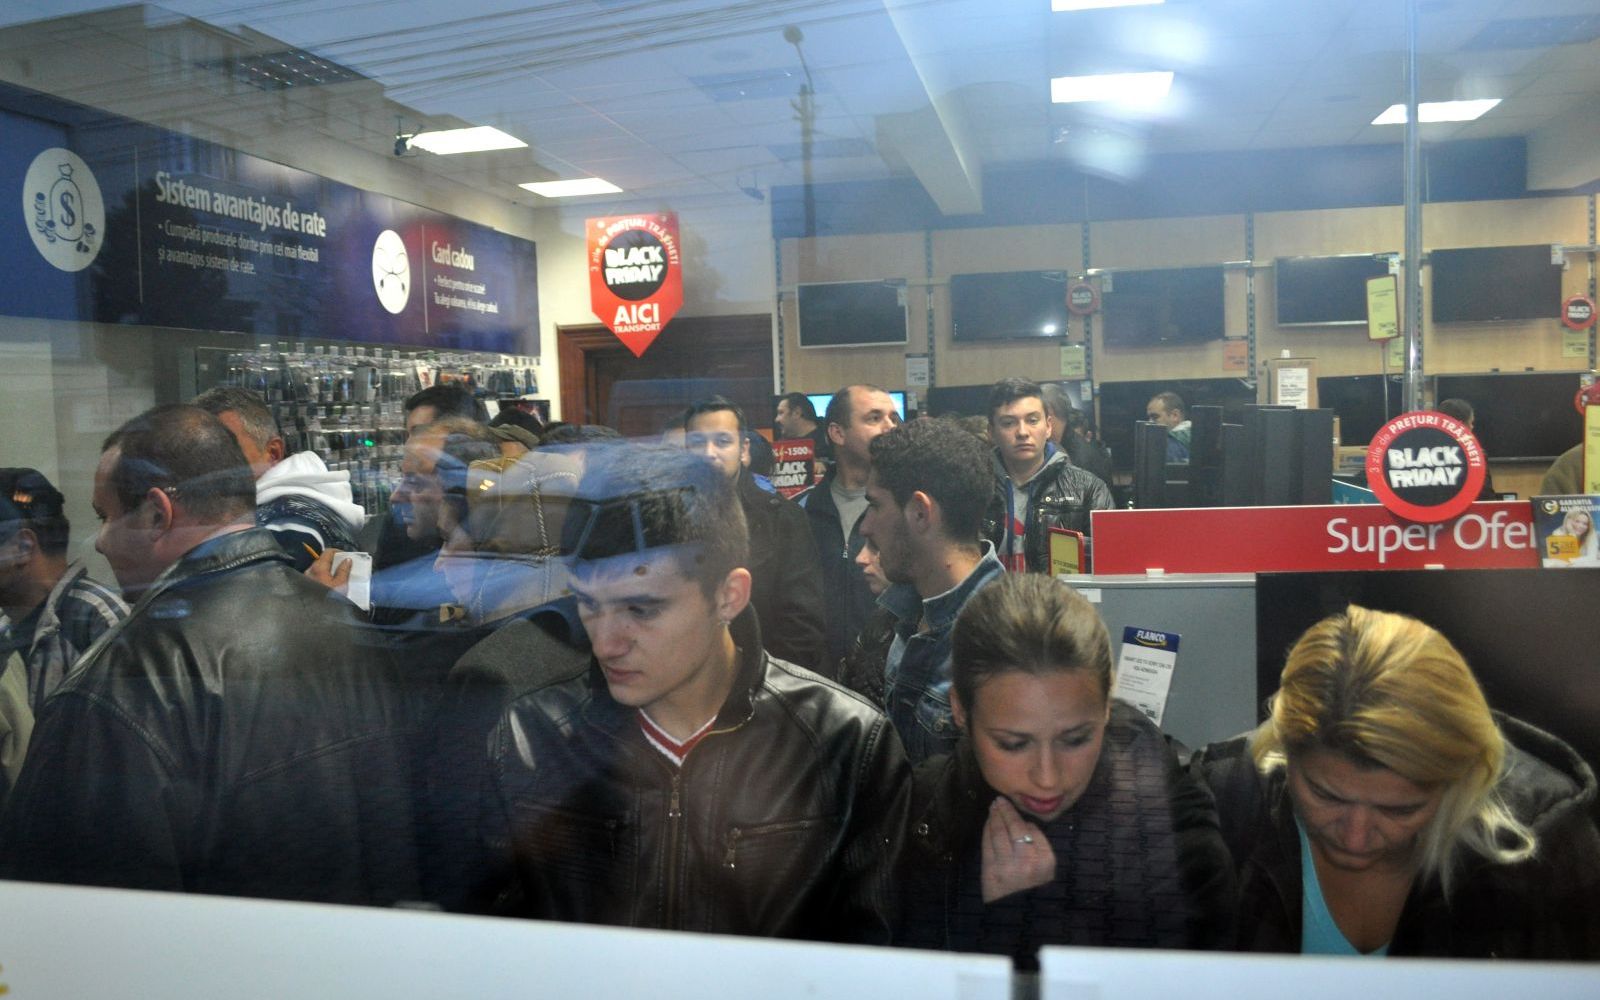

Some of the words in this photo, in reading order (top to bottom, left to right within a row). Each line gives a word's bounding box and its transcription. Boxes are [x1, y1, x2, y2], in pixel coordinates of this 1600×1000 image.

[155, 170, 211, 212] Sistem
[213, 191, 281, 232] avantajos
[282, 202, 300, 231] de
[301, 211, 327, 238] rate
[166, 249, 206, 270] avantajos
[205, 252, 230, 270] sistem
[230, 256, 240, 272] de
[432, 240, 451, 266] Card
[451, 246, 475, 271] cadou
[604, 245, 664, 268] BLACK
[605, 264, 664, 285] FRIDAY
[613, 303, 660, 326] AICI
[614, 323, 661, 334] TRANSPORT
[773, 461, 807, 476] LACK
[1387, 445, 1463, 470] BLACK
[1388, 466, 1463, 489] FRIDAY
[1326, 517, 1443, 564] Super
[1136, 629, 1166, 642] FLANCO
